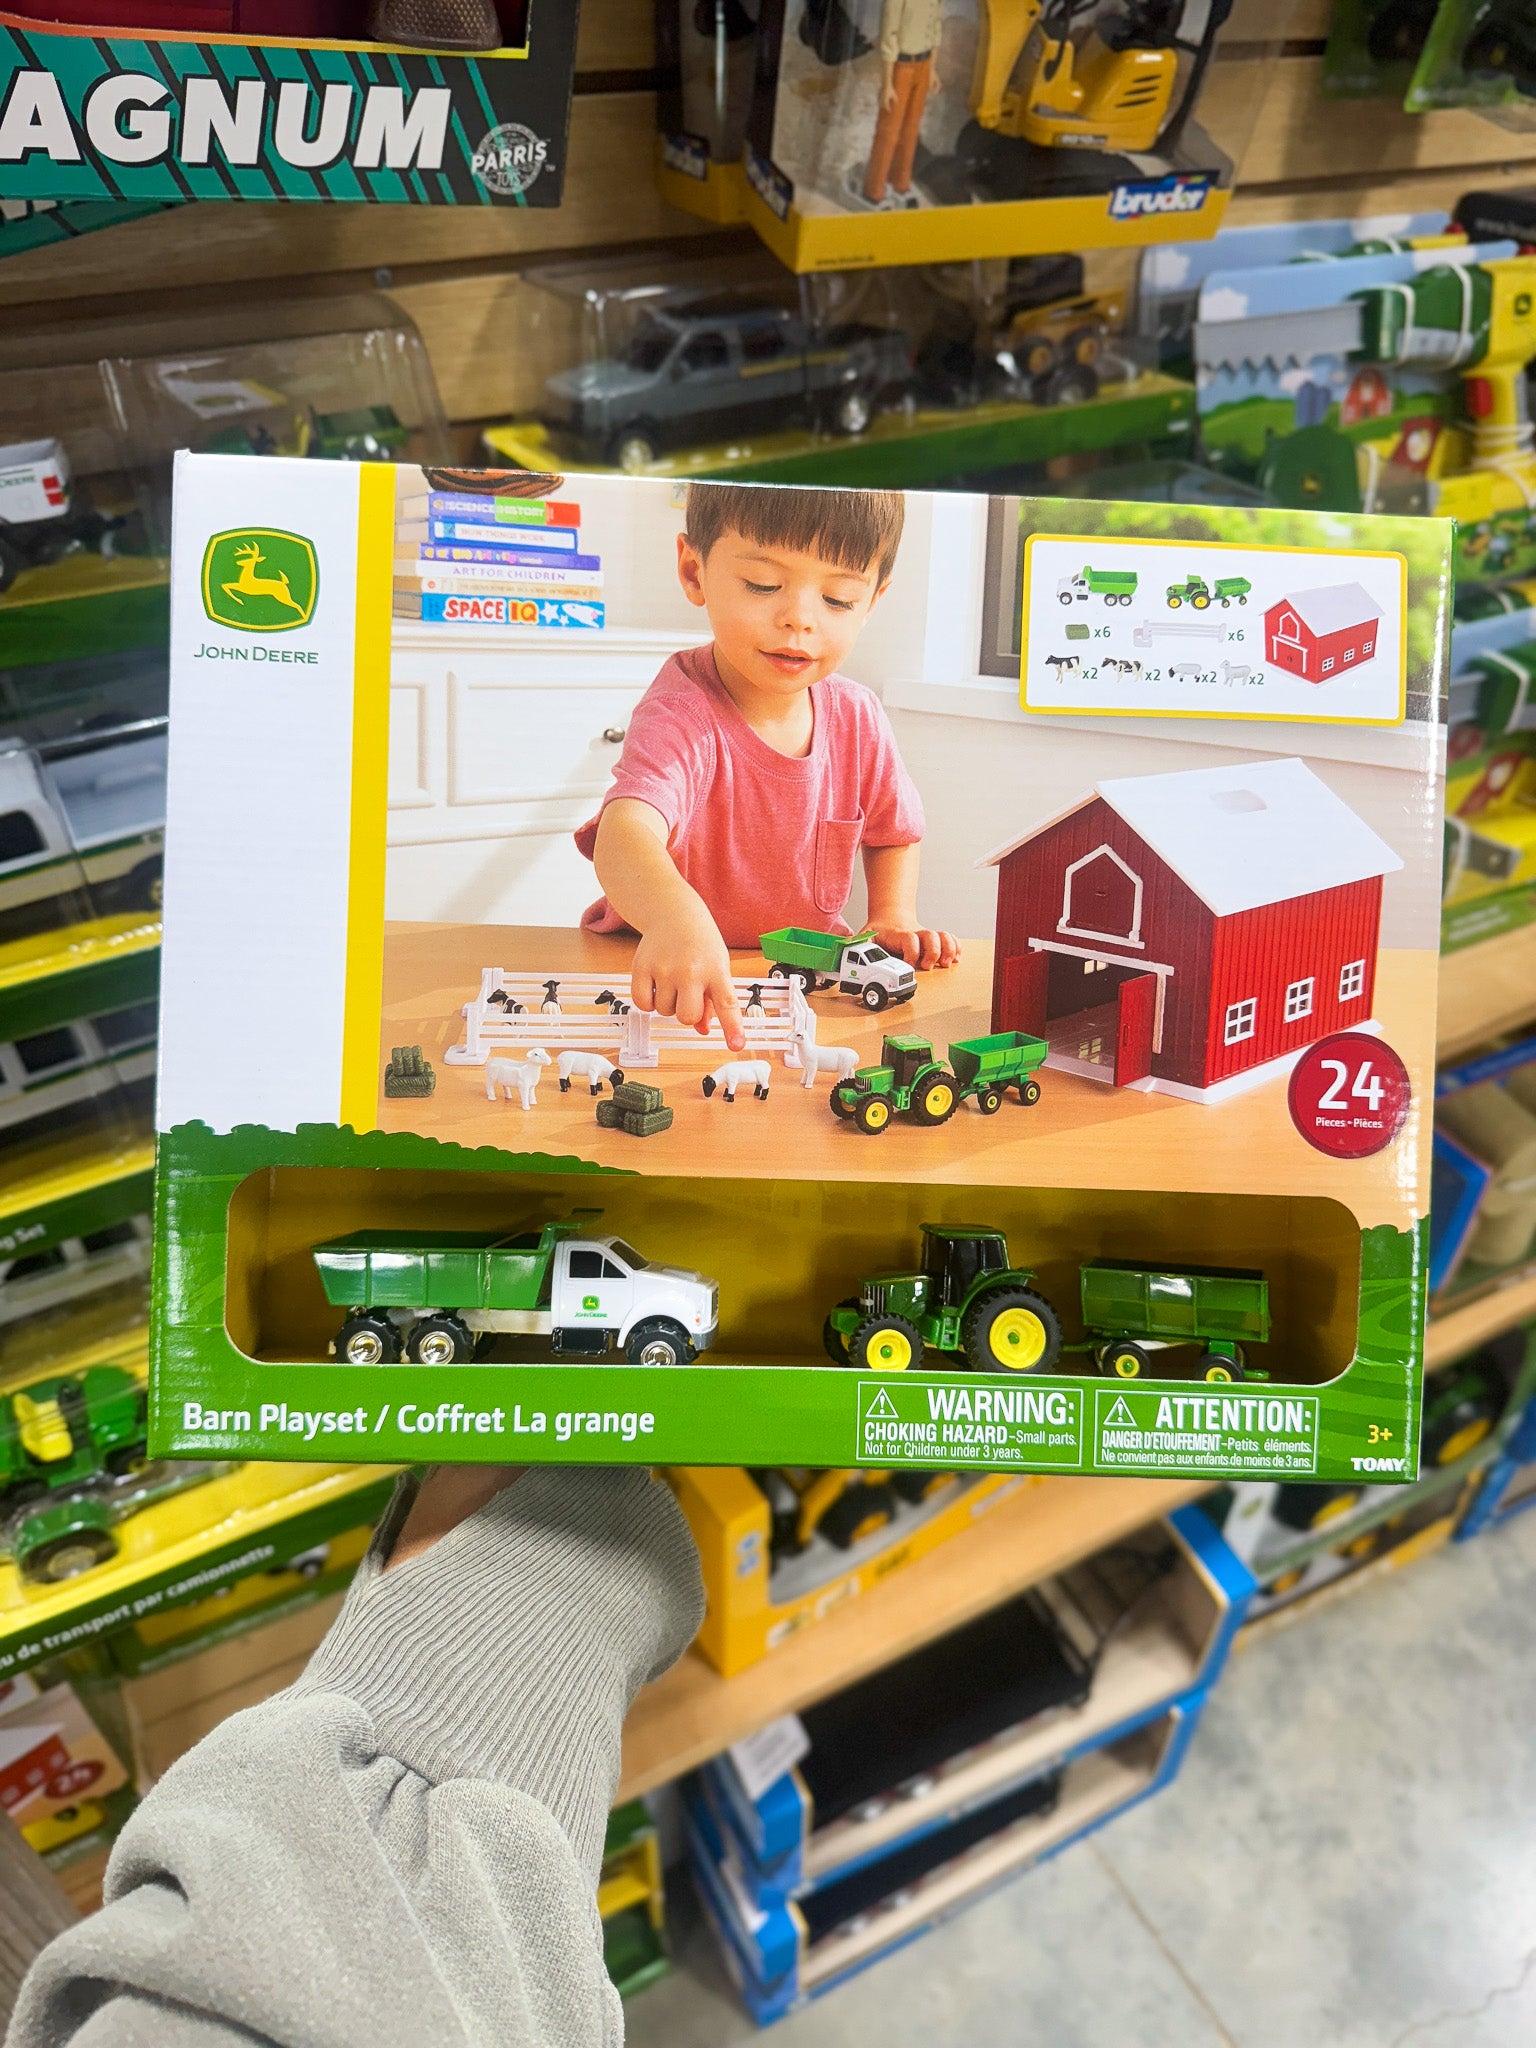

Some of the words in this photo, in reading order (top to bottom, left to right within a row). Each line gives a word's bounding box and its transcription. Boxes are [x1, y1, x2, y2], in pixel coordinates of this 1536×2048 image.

[471, 141, 547, 174] PARRIS
[1111, 183, 1204, 214] bruder
[453, 567, 479, 577] ART
[480, 568, 504, 578] FOR
[508, 569, 566, 581] CHILDREN
[445, 598, 504, 620] SPACE
[510, 599, 538, 622] IQ
[1094, 625, 1111, 639] x6
[1228, 628, 1245, 641] x6
[193, 643, 249, 661] JOHN
[252, 646, 319, 664] DEERE
[1082, 666, 1098, 680] x2
[1145, 668, 1161, 682] x2
[1201, 670, 1217, 684] x2
[1249, 672, 1264, 685] x2
[1318, 1059, 1386, 1111] 24
[1315, 1117, 1346, 1128] Pieces
[927, 1388, 1075, 1425] WARNING:
[1155, 1397, 1312, 1433] ATTENTION:
[183, 1402, 251, 1432] Barn
[260, 1404, 369, 1442] Playset
[374, 1405, 390, 1433] /
[397, 1403, 505, 1434] Coffret
[513, 1405, 547, 1434] La
[555, 1410, 655, 1443] grange
[864, 1421, 937, 1442] CHOKING
[1048, 1432, 1077, 1447] parts.
[1102, 1430, 1143, 1449] DANGER
[1367, 1424, 1393, 1444] 3+
[865, 1441, 883, 1455] Not
[886, 1442, 901, 1456] for
[904, 1442, 947, 1457] Children
[950, 1444, 980, 1458] under
[983, 1444, 990, 1458] 3
[992, 1446, 1024, 1461] years.
[1101, 1448, 1115, 1463] Ne
[1117, 1450, 1157, 1464] convient
[1158, 1454, 1175, 1467] pas
[1176, 1453, 1194, 1465] aux
[1195, 1452, 1229, 1466] enfants
[1230, 1453, 1242, 1466] de
[1243, 1454, 1271, 1467] moins
[1272, 1454, 1284, 1467] de
[1285, 1455, 1293, 1467] 3
[1293, 1456, 1312, 1468] ans.
[1350, 1456, 1406, 1472] TOMY
[17, 1641, 41, 1660] de
[43, 1603, 132, 1650] transport
[133, 1590, 164, 1614] par
[166, 1544, 275, 1599] camionnette
